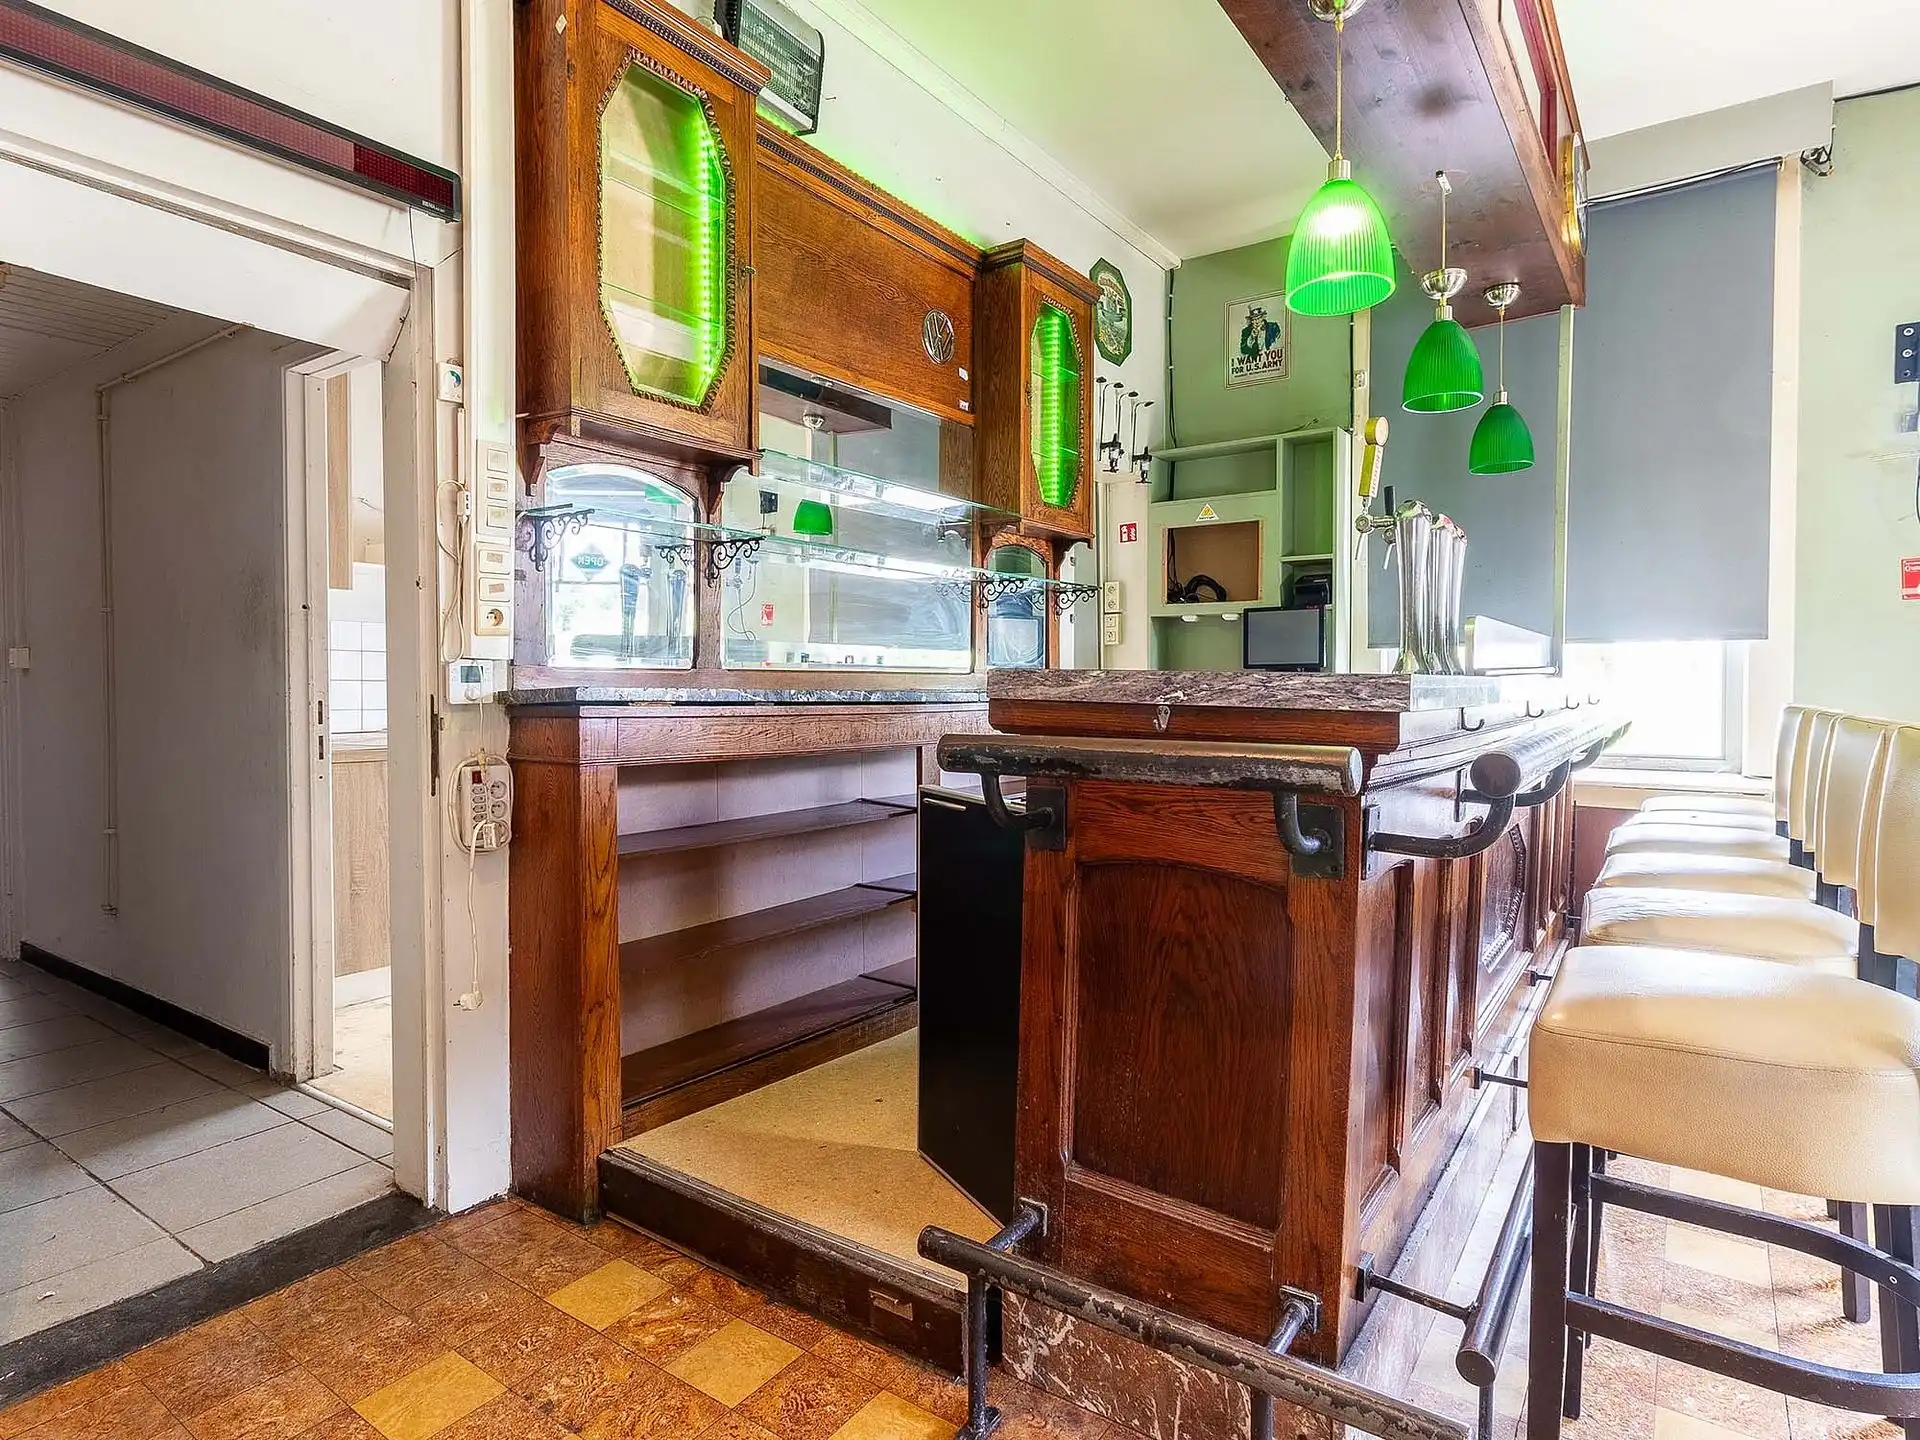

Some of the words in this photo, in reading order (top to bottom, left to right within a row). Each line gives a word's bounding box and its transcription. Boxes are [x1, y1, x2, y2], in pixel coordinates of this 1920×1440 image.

[1236, 353, 1263, 366] WANT
[1264, 349, 1283, 361] YOU
[1231, 366, 1244, 375] FOR
